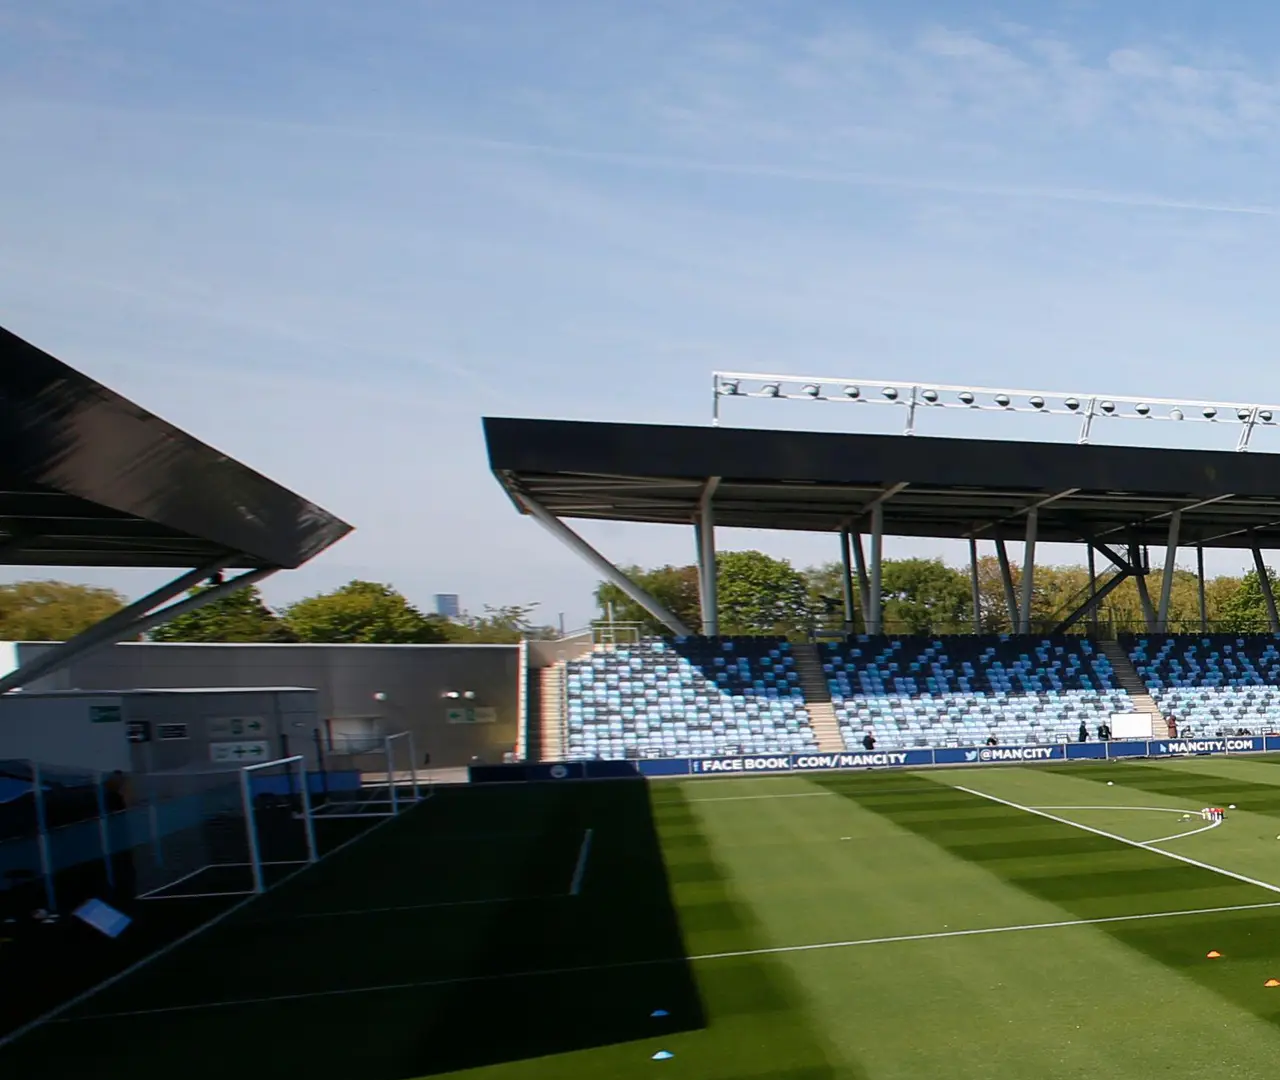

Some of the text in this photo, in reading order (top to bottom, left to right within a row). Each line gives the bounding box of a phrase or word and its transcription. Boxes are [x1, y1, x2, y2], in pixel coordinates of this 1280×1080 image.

[980, 746, 1053, 760] @MANCITY
[1168, 739, 1253, 753] MANCITY.COM
[702, 753, 908, 772] FACEBOOK.COM/MANCITY
